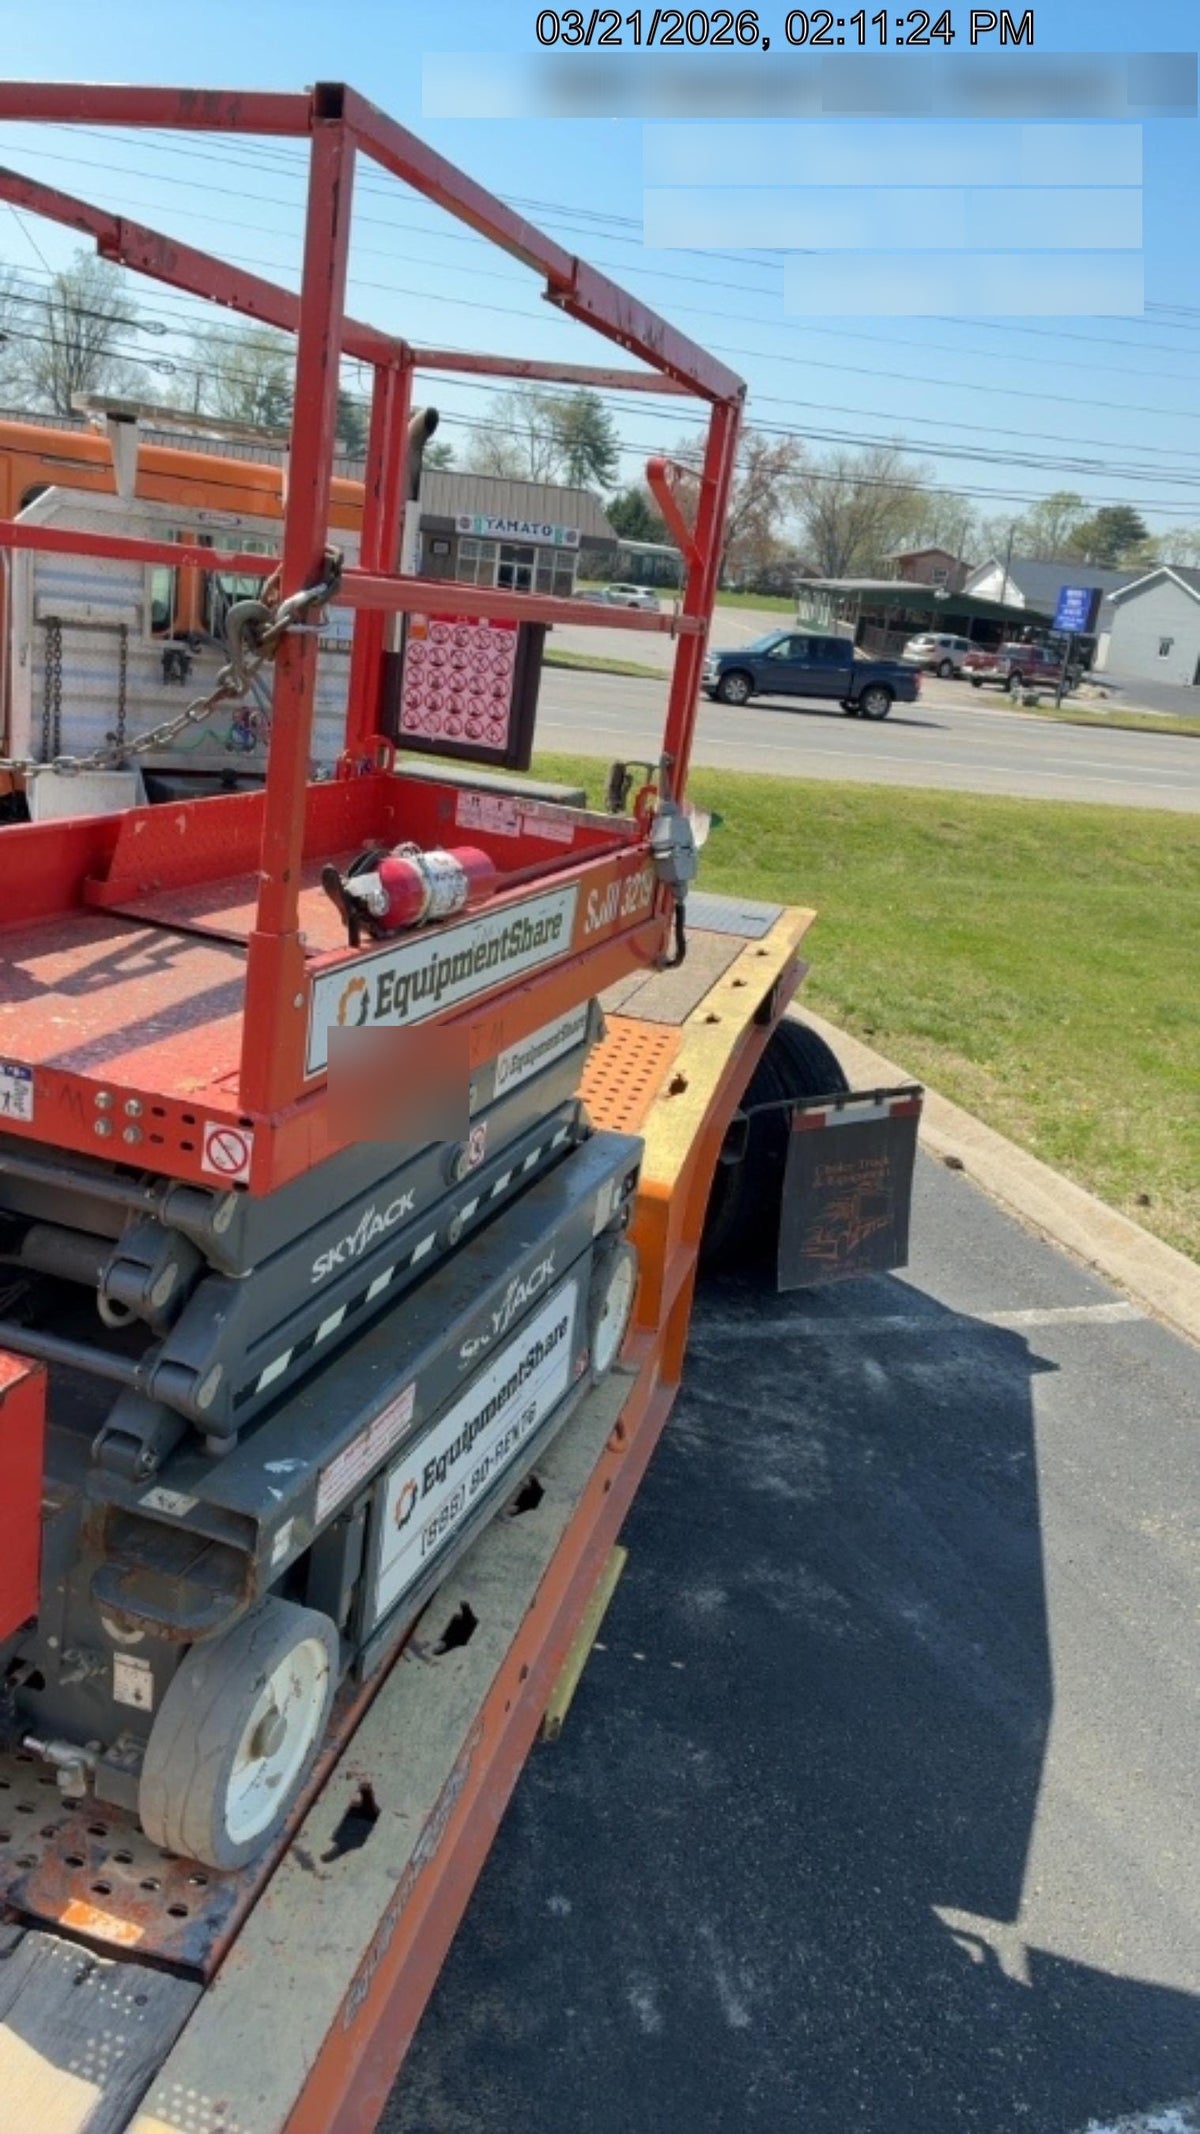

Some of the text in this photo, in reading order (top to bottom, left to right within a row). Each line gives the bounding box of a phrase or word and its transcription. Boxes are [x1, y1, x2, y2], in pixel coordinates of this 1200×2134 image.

[374, 912, 563, 1018] EquipmentShare
[311, 1187, 416, 1284] SKYJACK
[421, 1315, 569, 1499] EquipmentShare
